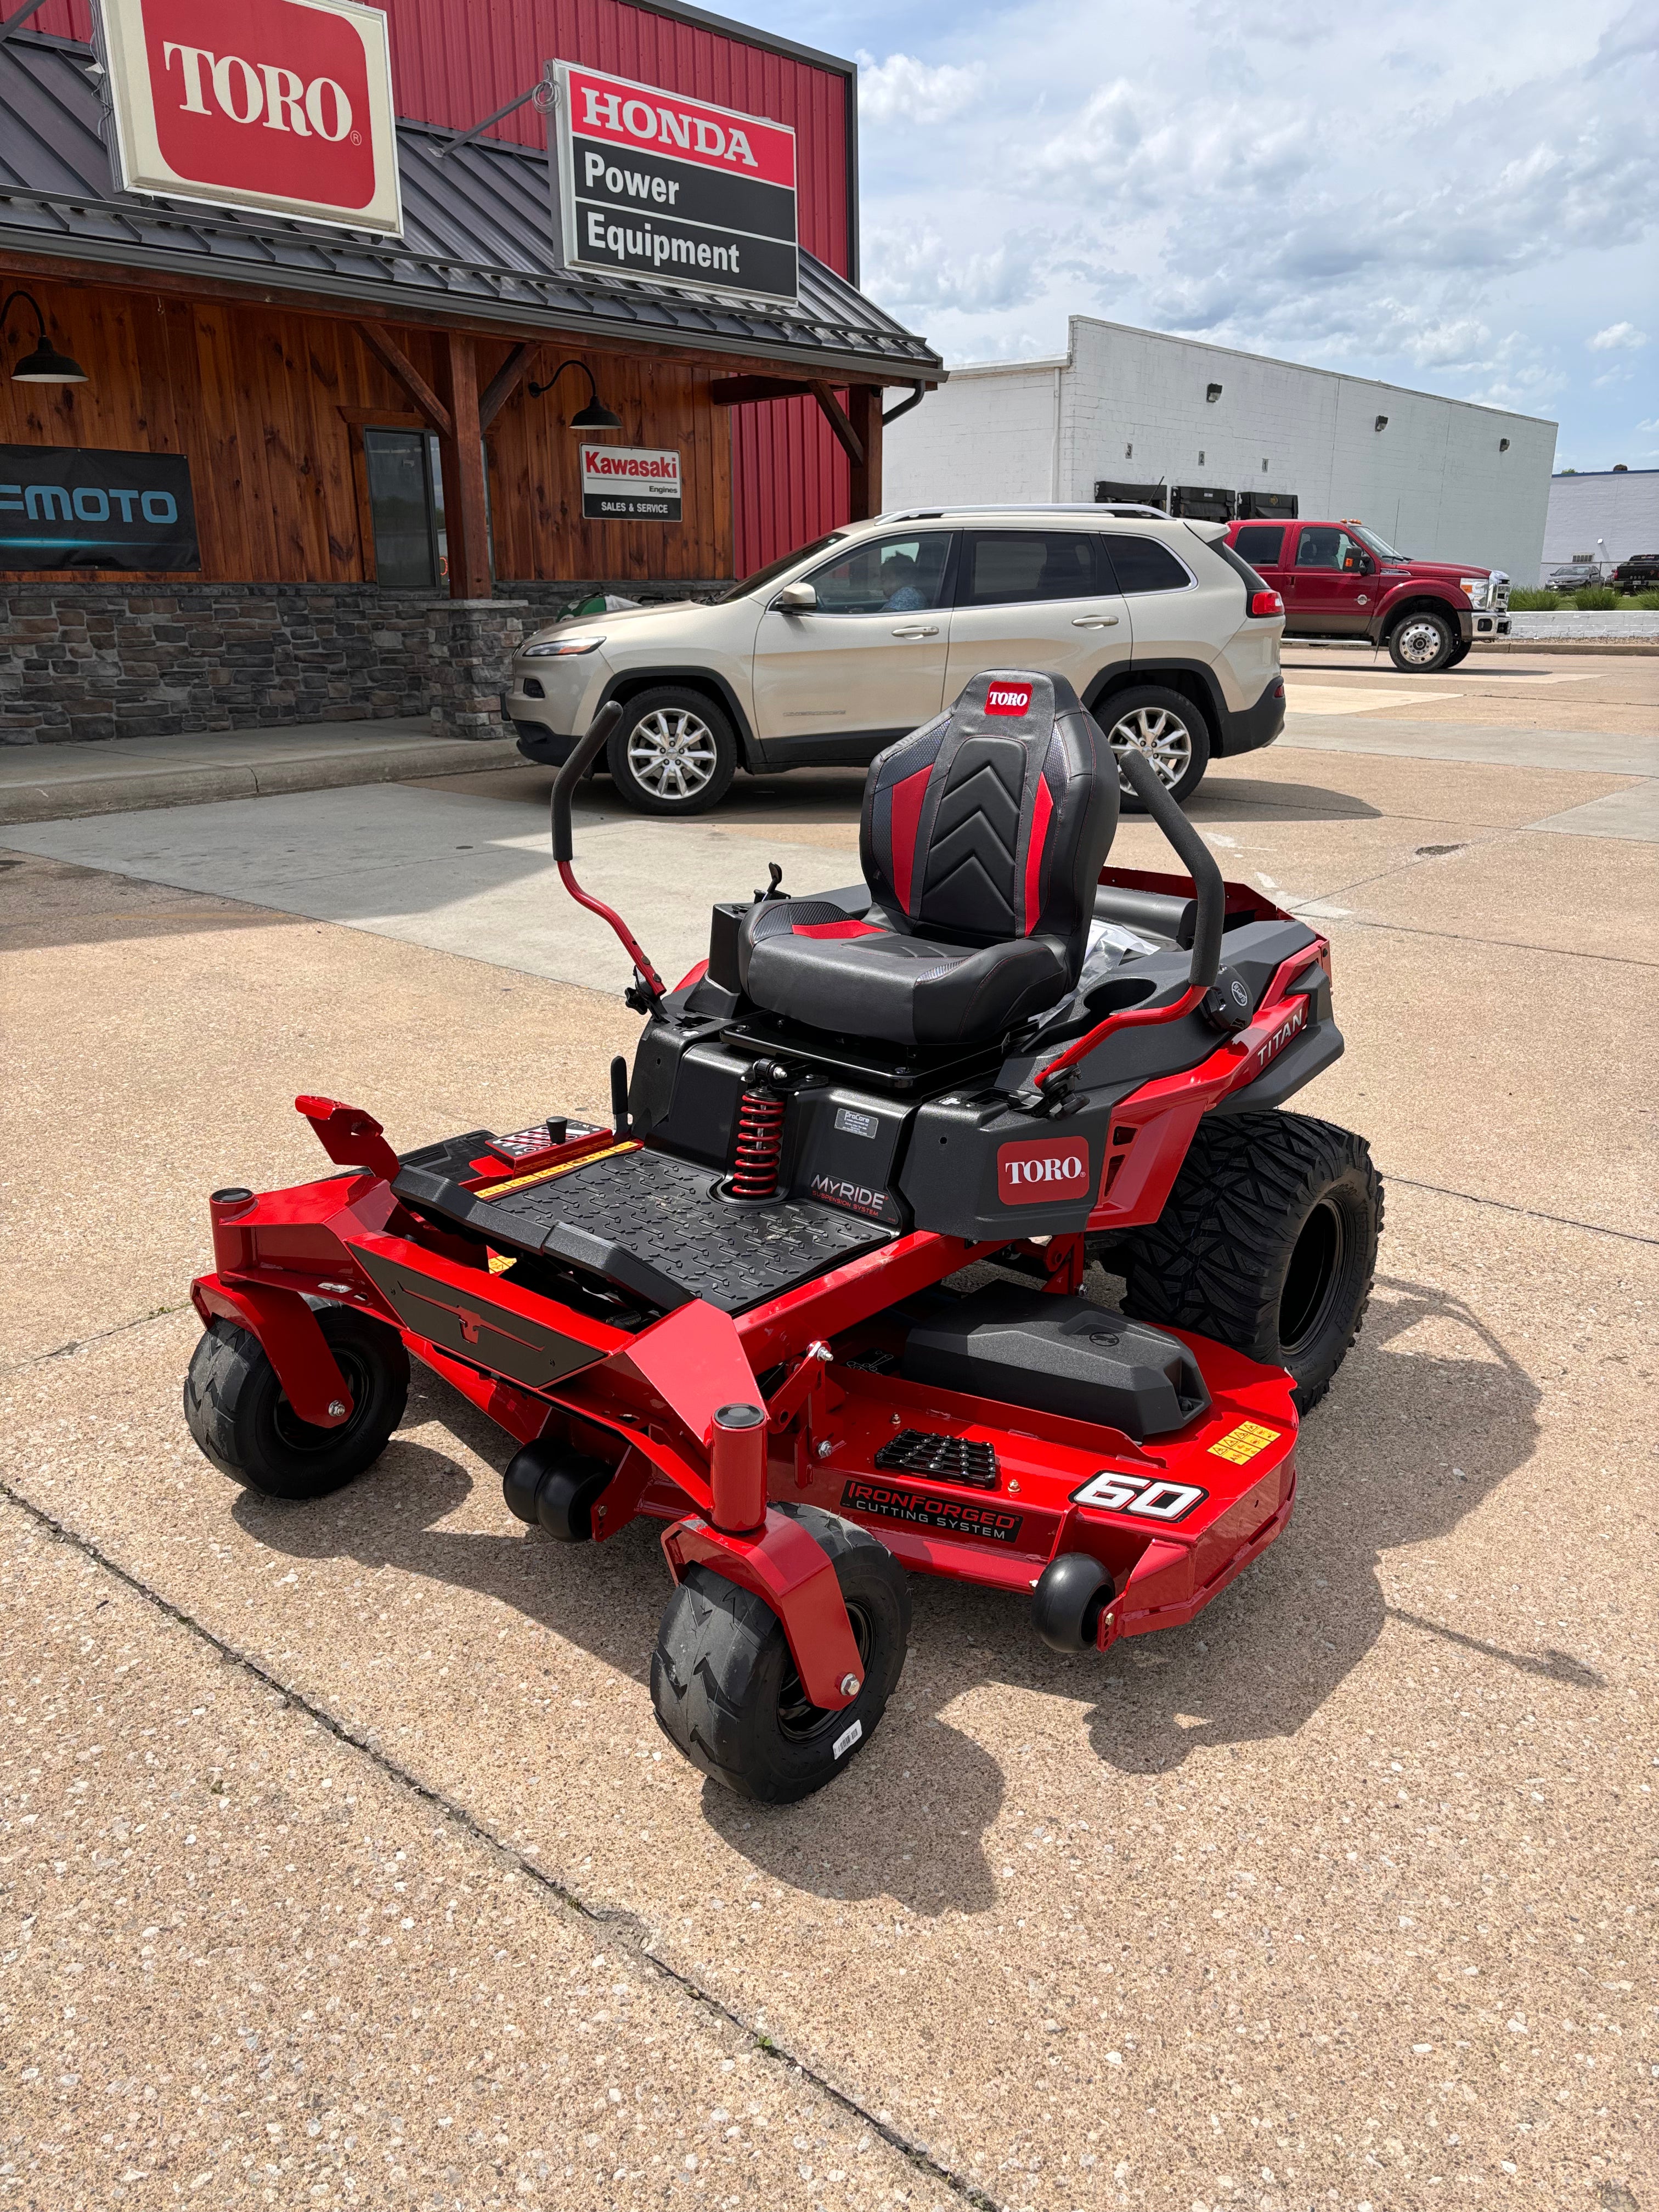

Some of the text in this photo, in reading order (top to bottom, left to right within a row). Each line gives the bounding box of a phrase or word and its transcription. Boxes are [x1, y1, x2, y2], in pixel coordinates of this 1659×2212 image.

[162, 41, 353, 142] TORO
[581, 87, 758, 167] HONDA
[585, 151, 680, 205] Power
[587, 211, 740, 273] Equipment
[585, 451, 677, 478] Kawasaki
[601, 501, 669, 514] SALES & SERVICE
[989, 692, 1028, 707] TORO
[1257, 1008, 1302, 1066] TITAN
[1005, 1156, 1082, 1185] TORO
[812, 1190, 879, 1216] SUSPENSION SYSTEM
[848, 1482, 1015, 1529] IRONFORGED
[856, 1500, 1006, 1539] CUTTING SYSTEM
[1073, 1472, 1204, 1520] 60
